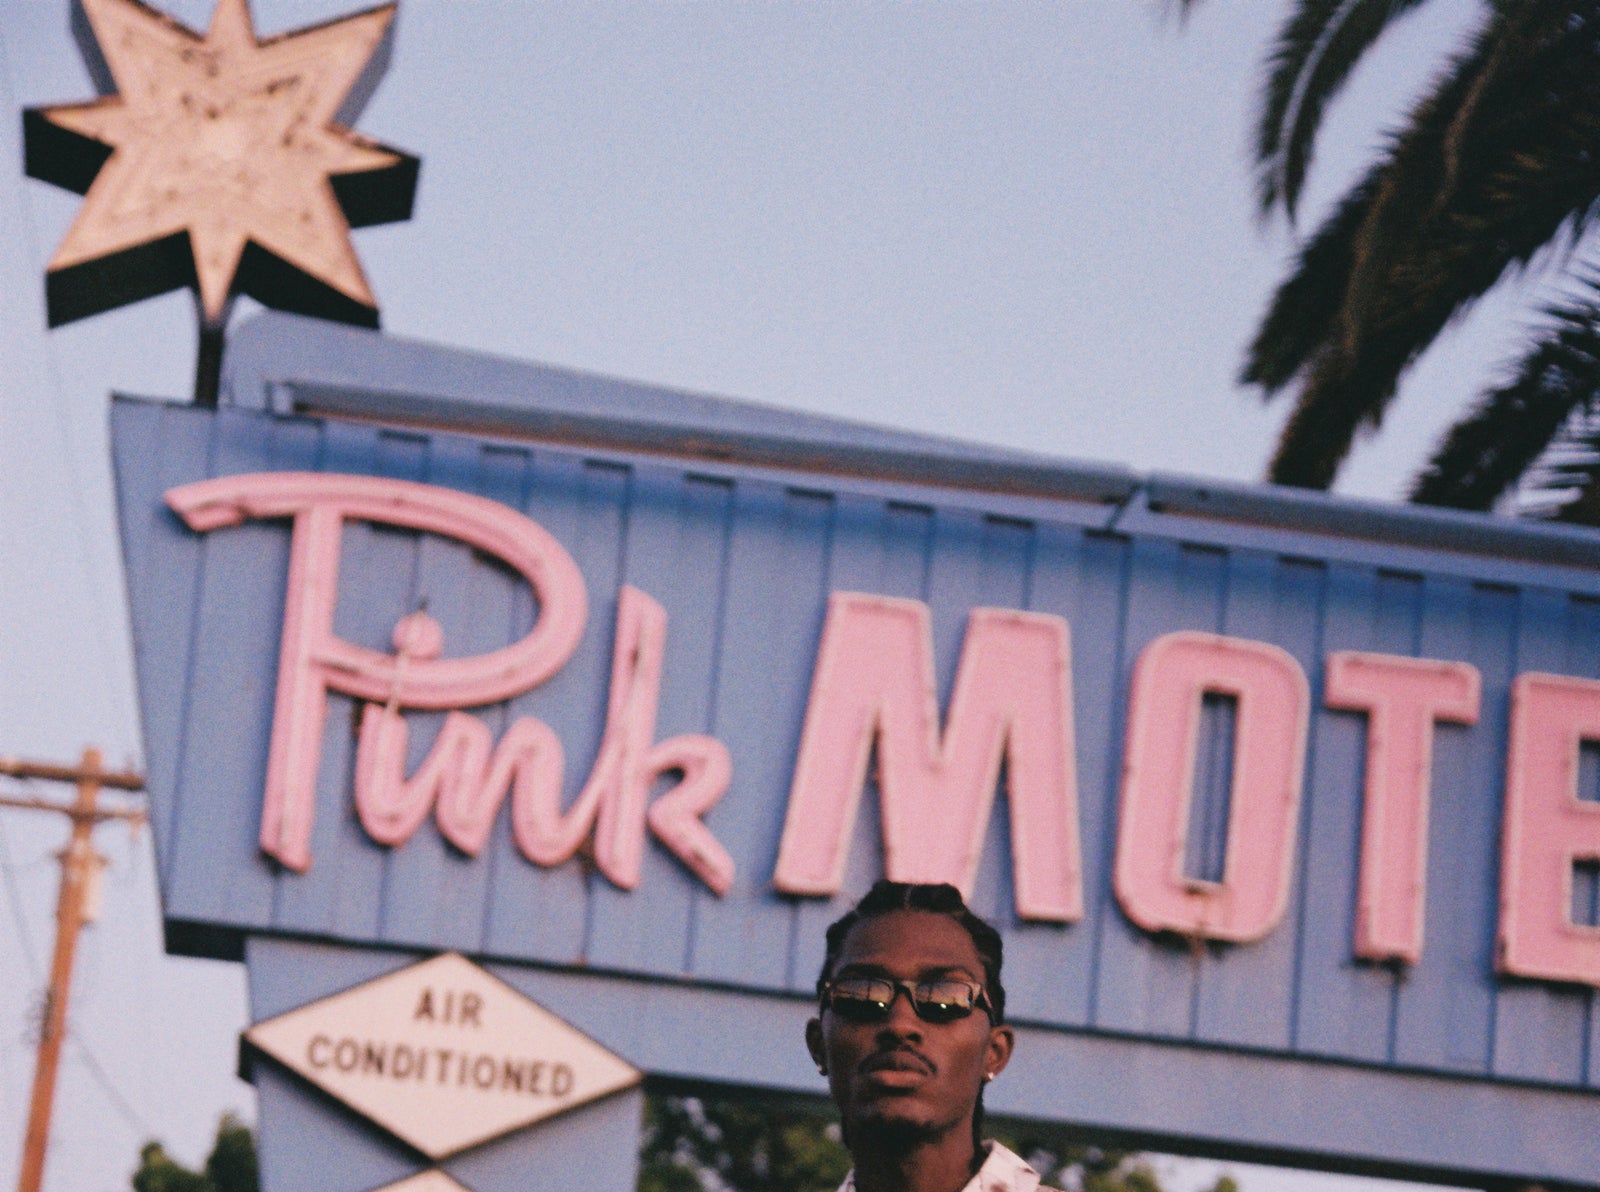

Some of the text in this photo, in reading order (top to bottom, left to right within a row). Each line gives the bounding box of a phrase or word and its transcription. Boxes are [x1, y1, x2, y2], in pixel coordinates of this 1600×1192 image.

[164, 471, 736, 898] Pink
[413, 987, 484, 1028] AIR
[307, 1035, 575, 1098] CONDITIONED
